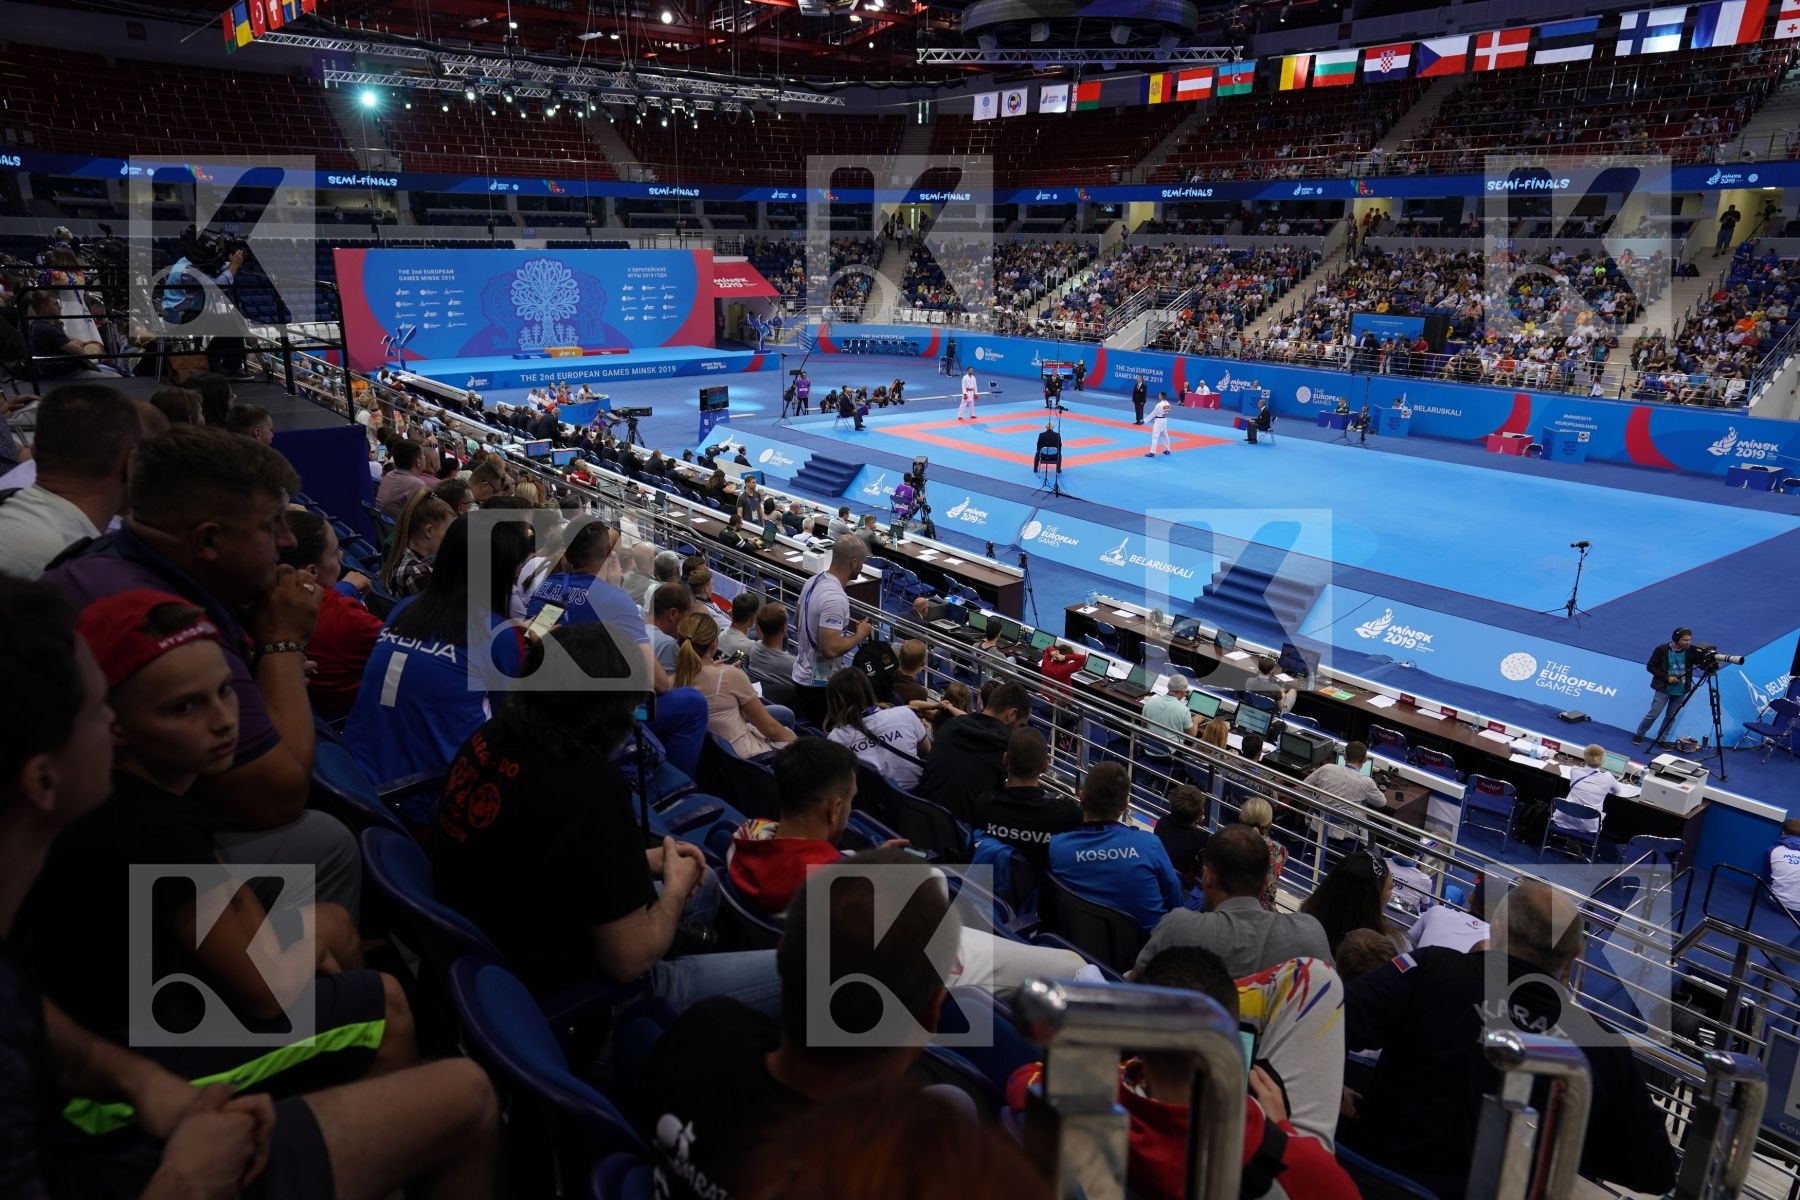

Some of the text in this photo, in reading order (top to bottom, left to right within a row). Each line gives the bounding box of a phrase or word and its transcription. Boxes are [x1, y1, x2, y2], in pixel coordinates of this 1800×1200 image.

[521, 364, 676, 383] THE 2nd EUROPEAN GAMES MINSK 2019
[1136, 367, 1164, 376] EUROPEAN
[1413, 404, 1462, 416] BELARUSKALI
[1736, 439, 1779, 452] MINSK
[1735, 447, 1766, 460] 2019
[960, 512, 979, 524] 2019
[966, 505, 989, 518] MINSK
[1045, 524, 1062, 535] THE
[1037, 535, 1060, 548] GAMES
[1041, 530, 1079, 547] EUROPEAN
[1129, 554, 1194, 580] BELARUSKALI
[1387, 623, 1435, 645] MINSK
[1382, 634, 1417, 650] 2019
[1545, 660, 1571, 674] THE
[380, 650, 409, 708] 1
[1539, 668, 1617, 697] EUROPEAN
[1535, 678, 1582, 698] GAMES
[1424, 753, 1443, 765] Judge
[1481, 781, 1502, 793] Judge
[987, 822, 1052, 844] KOSOVA
[1076, 847, 1140, 862] KOSOVA
